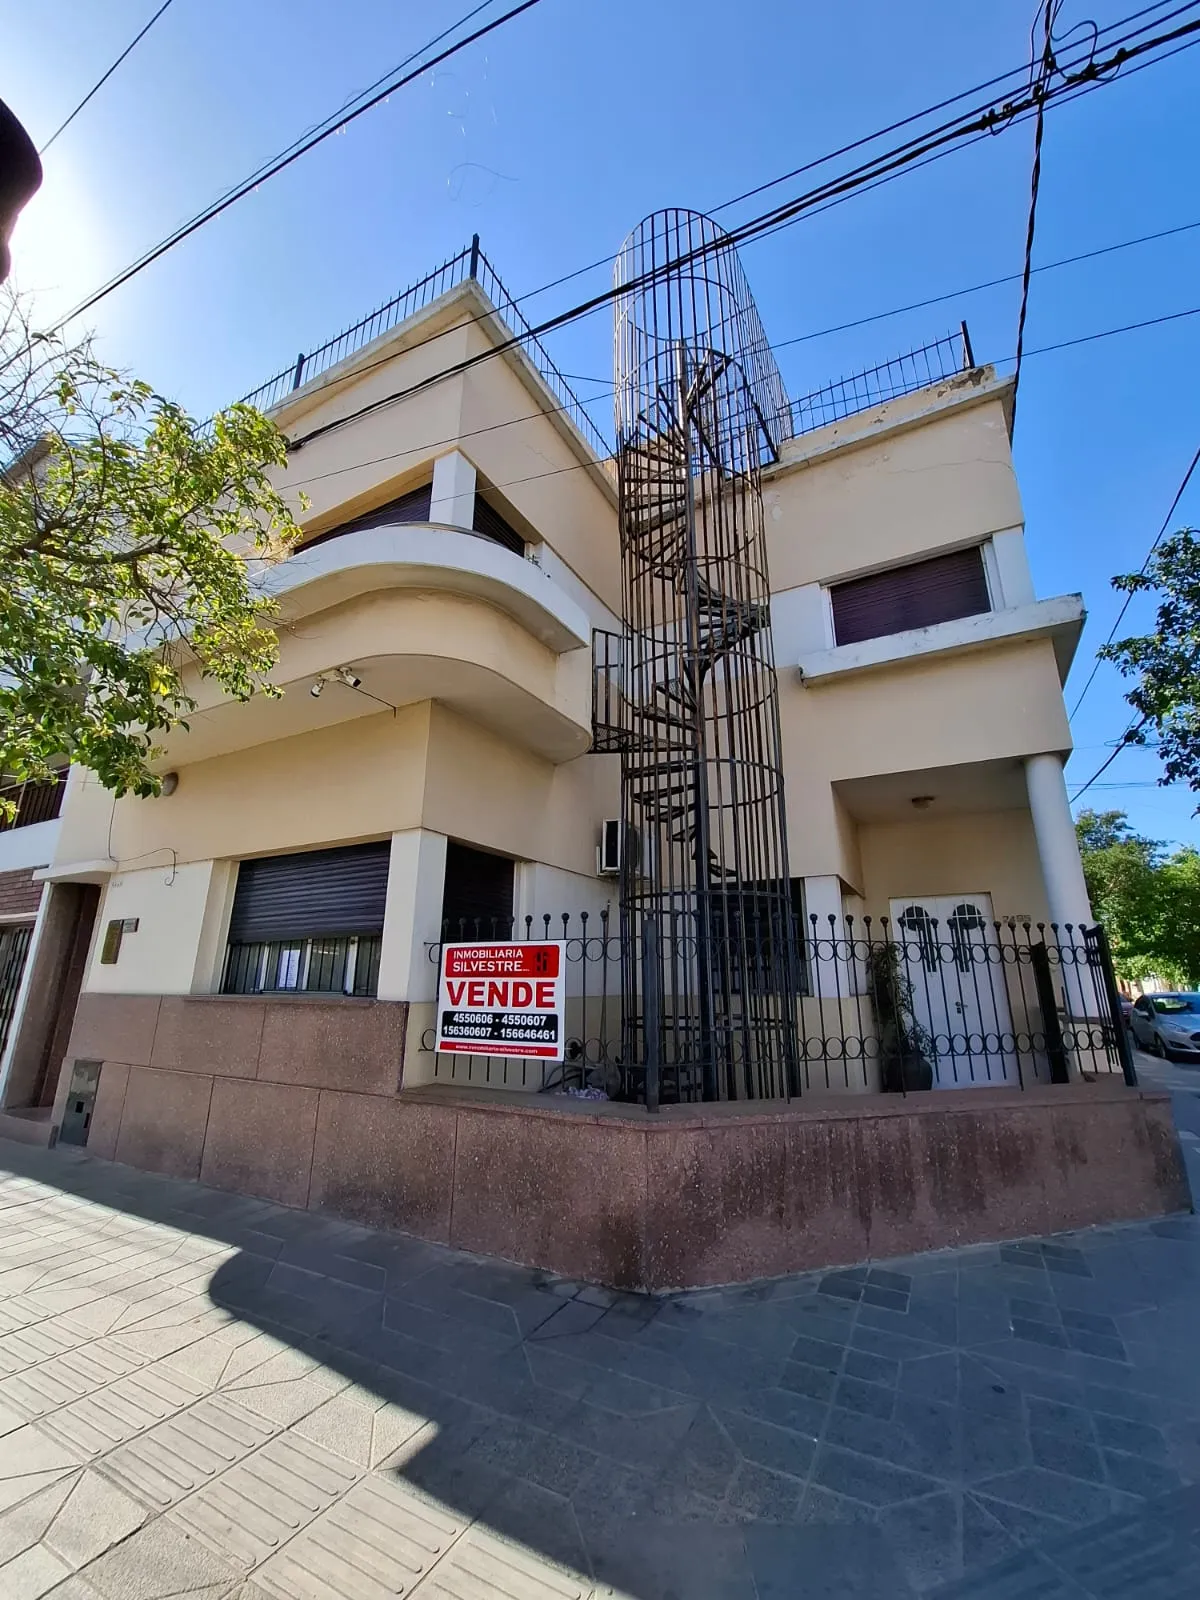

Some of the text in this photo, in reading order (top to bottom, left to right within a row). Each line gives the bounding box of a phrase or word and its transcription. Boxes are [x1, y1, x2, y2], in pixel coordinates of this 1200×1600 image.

[453, 949, 523, 959] INMOBILIARIA
[453, 961, 523, 972] SILVESTRE
[446, 981, 555, 1008] VENDE
[453, 1013, 493, 1024] 4550606
[501, 1014, 547, 1026] 4550607
[500, 1028, 555, 1040] 156646461
